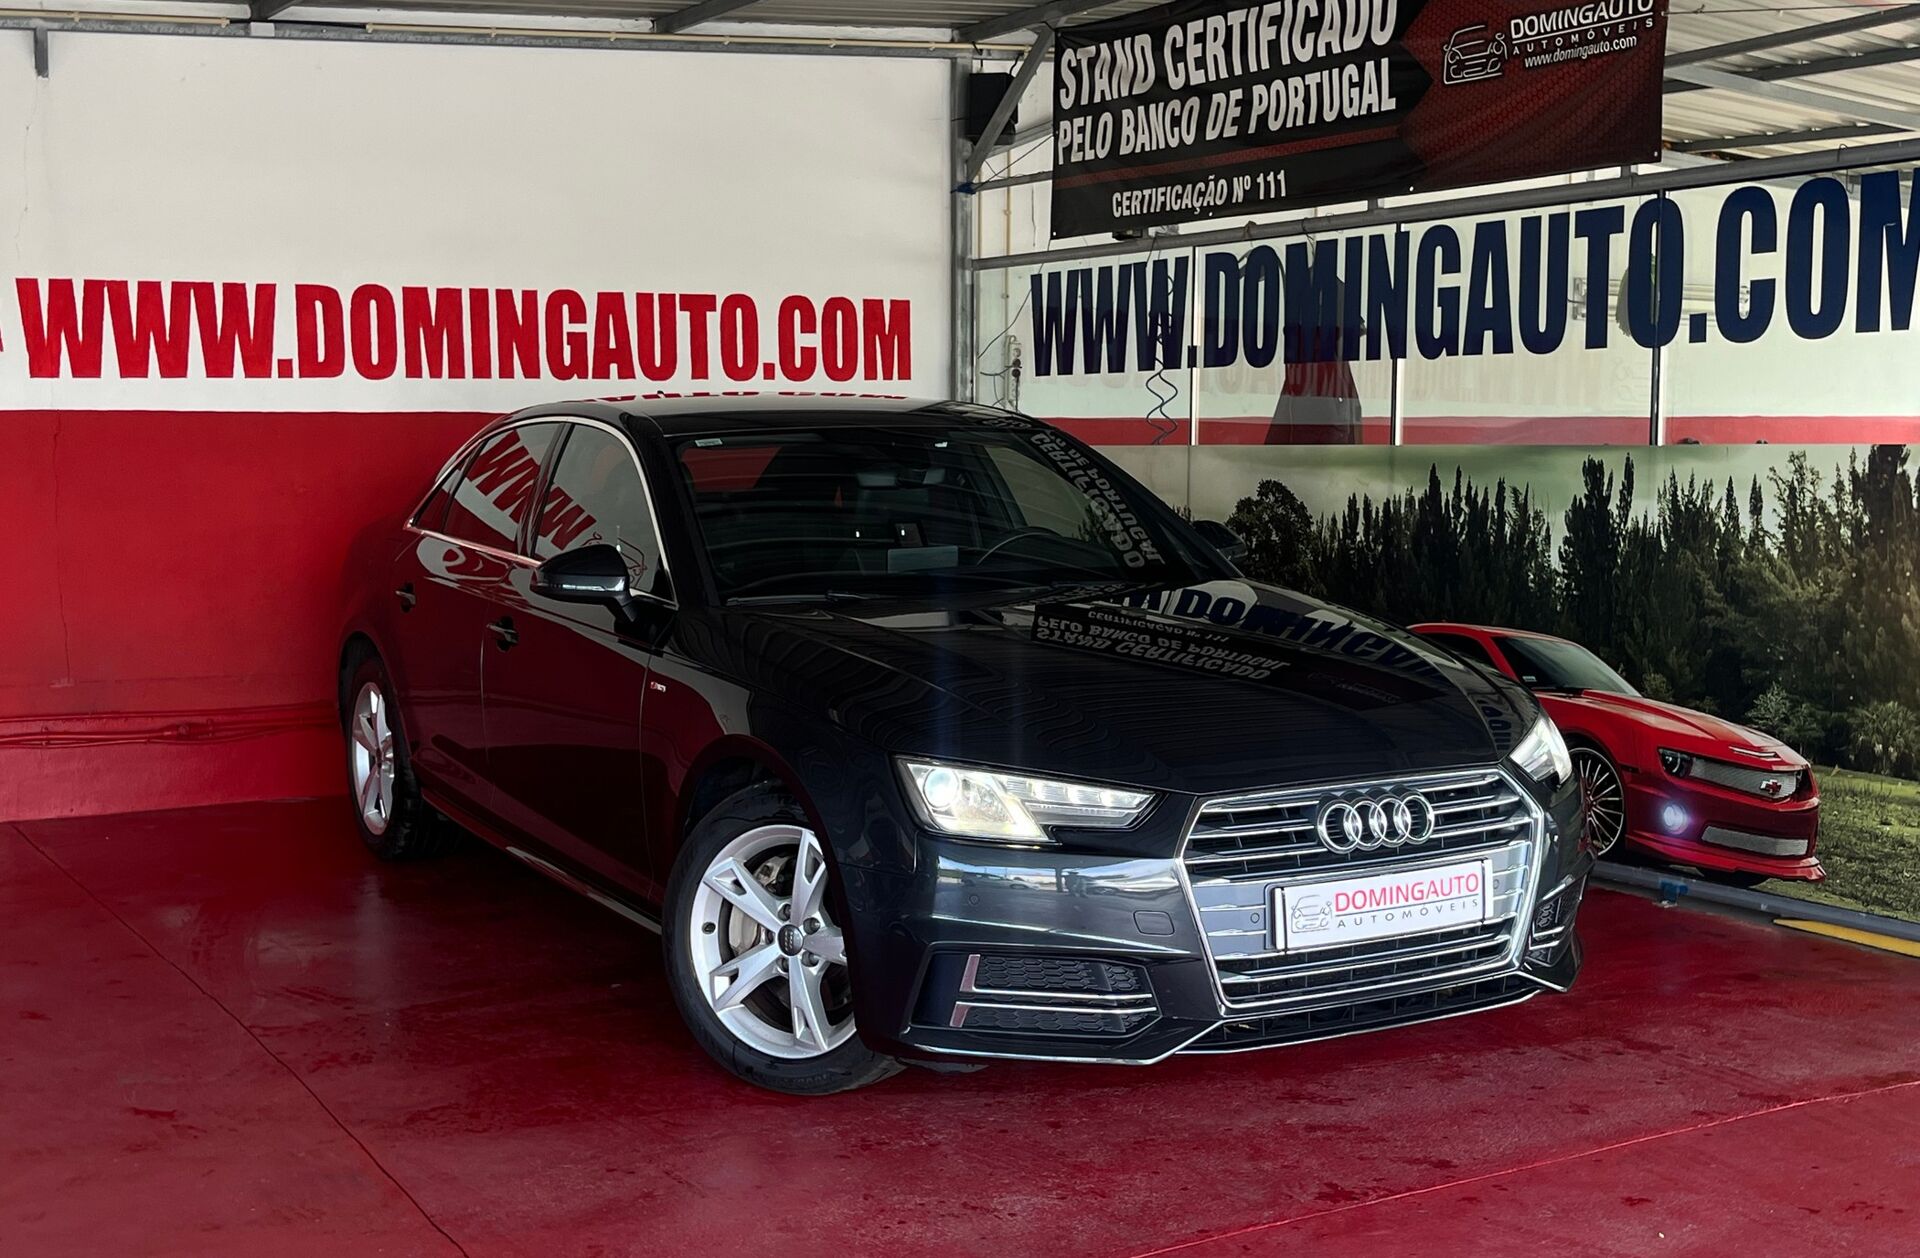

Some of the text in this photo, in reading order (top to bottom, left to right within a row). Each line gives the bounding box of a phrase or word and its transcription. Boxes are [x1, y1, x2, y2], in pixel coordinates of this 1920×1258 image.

[1511, 0, 1653, 39] DOMINGAUTO
[1060, 0, 1397, 110] STAND CERTIFICADO
[1524, 35, 1637, 68] www.domingauto.com
[1058, 57, 1397, 165] PELO BANCO DE PORTUGAL
[1112, 174, 1228, 218] CERTIFICAÇÃO
[1256, 169, 1286, 200] 111
[15, 277, 912, 382] WWW.DOMINGAUTO.COM
[1335, 873, 1479, 913] DOMINGAUTO
[1337, 898, 1479, 928] AUTOMÓVEIS
